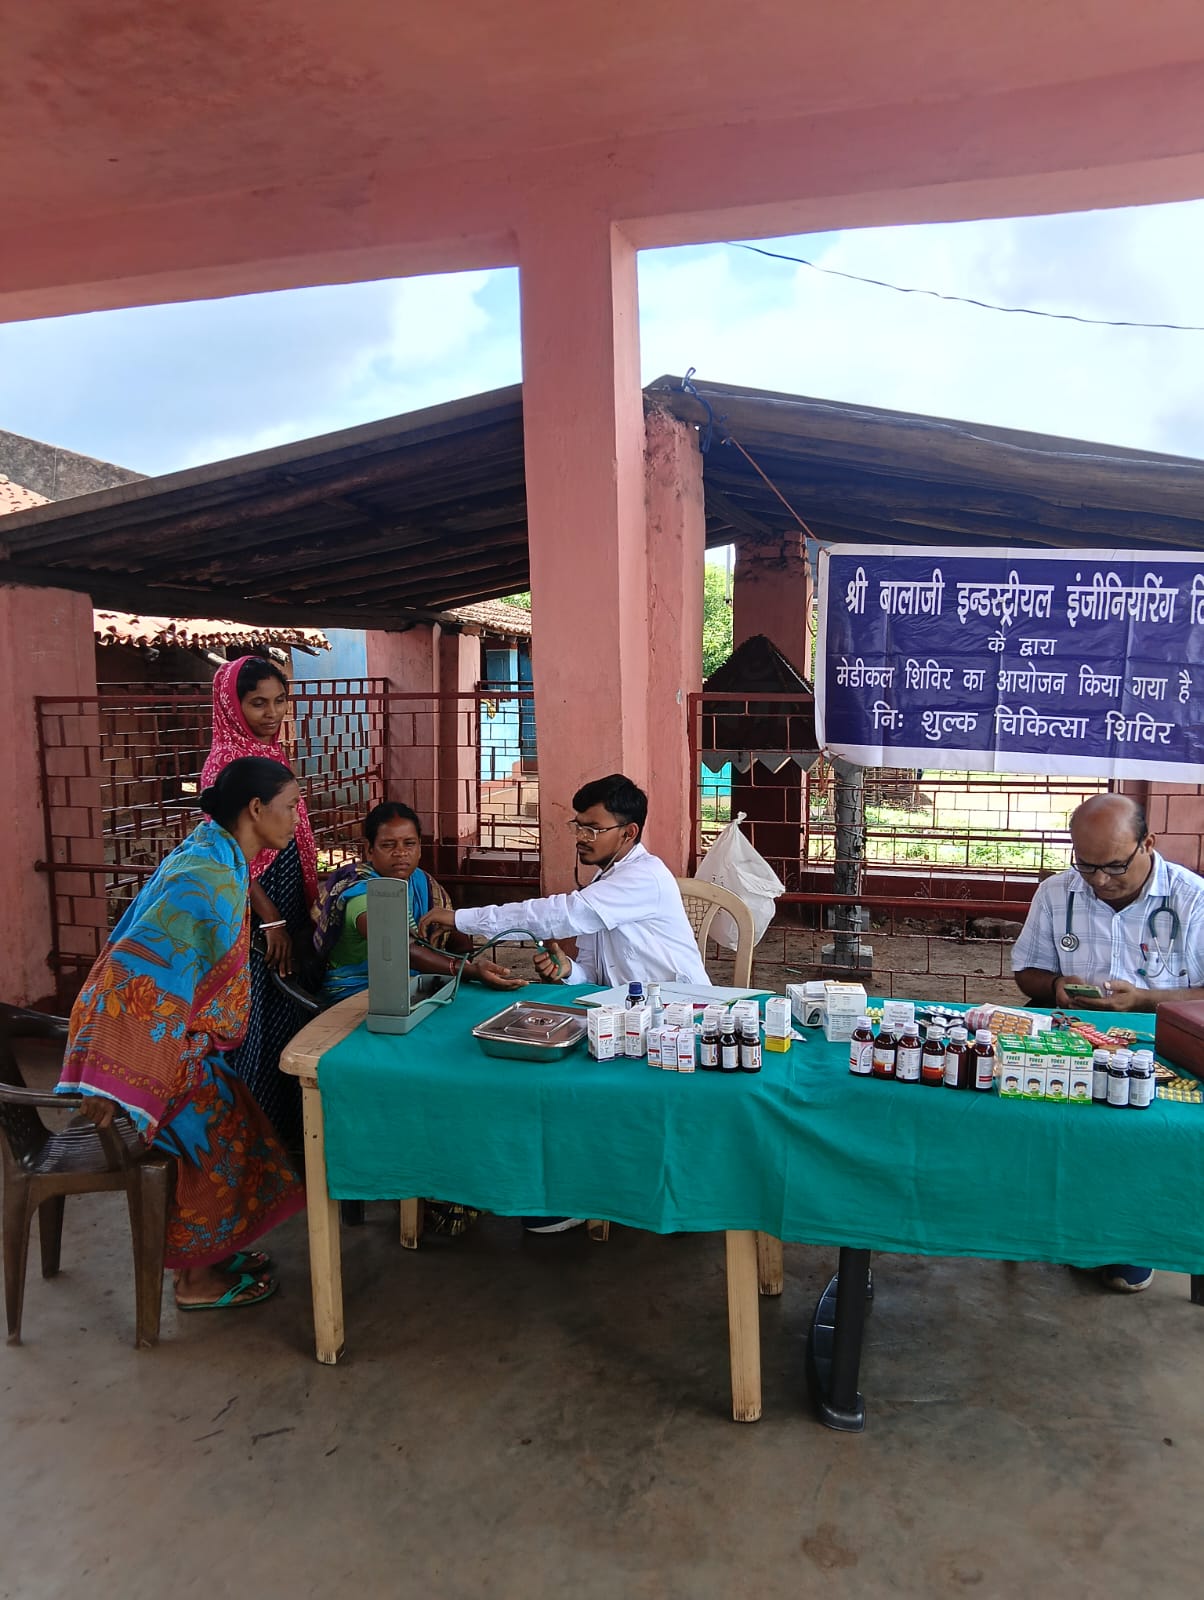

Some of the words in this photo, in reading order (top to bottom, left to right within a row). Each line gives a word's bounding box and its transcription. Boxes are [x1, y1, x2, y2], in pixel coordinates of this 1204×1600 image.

[845, 566, 869, 615] श्री
[879, 568, 946, 616] बालाजी
[956, 570, 1055, 627] इन्डस्ट्रीयल
[1066, 572, 1179, 628] इंजीनियरिंग
[987, 630, 1006, 653] के
[1018, 638, 1058, 656] द्वारा
[835, 657, 895, 689] मेडीकल
[904, 658, 954, 690] शिविर
[962, 669, 986, 691] का
[996, 661, 1068, 695] आयोजन
[1078, 664, 1122, 697] किया
[1132, 676, 1168, 700] गया
[1178, 669, 1193, 704] है
[921, 710, 979, 741] शुल्क
[994, 704, 1090, 739] चिकित्सा
[1105, 710, 1176, 744] शिविर
